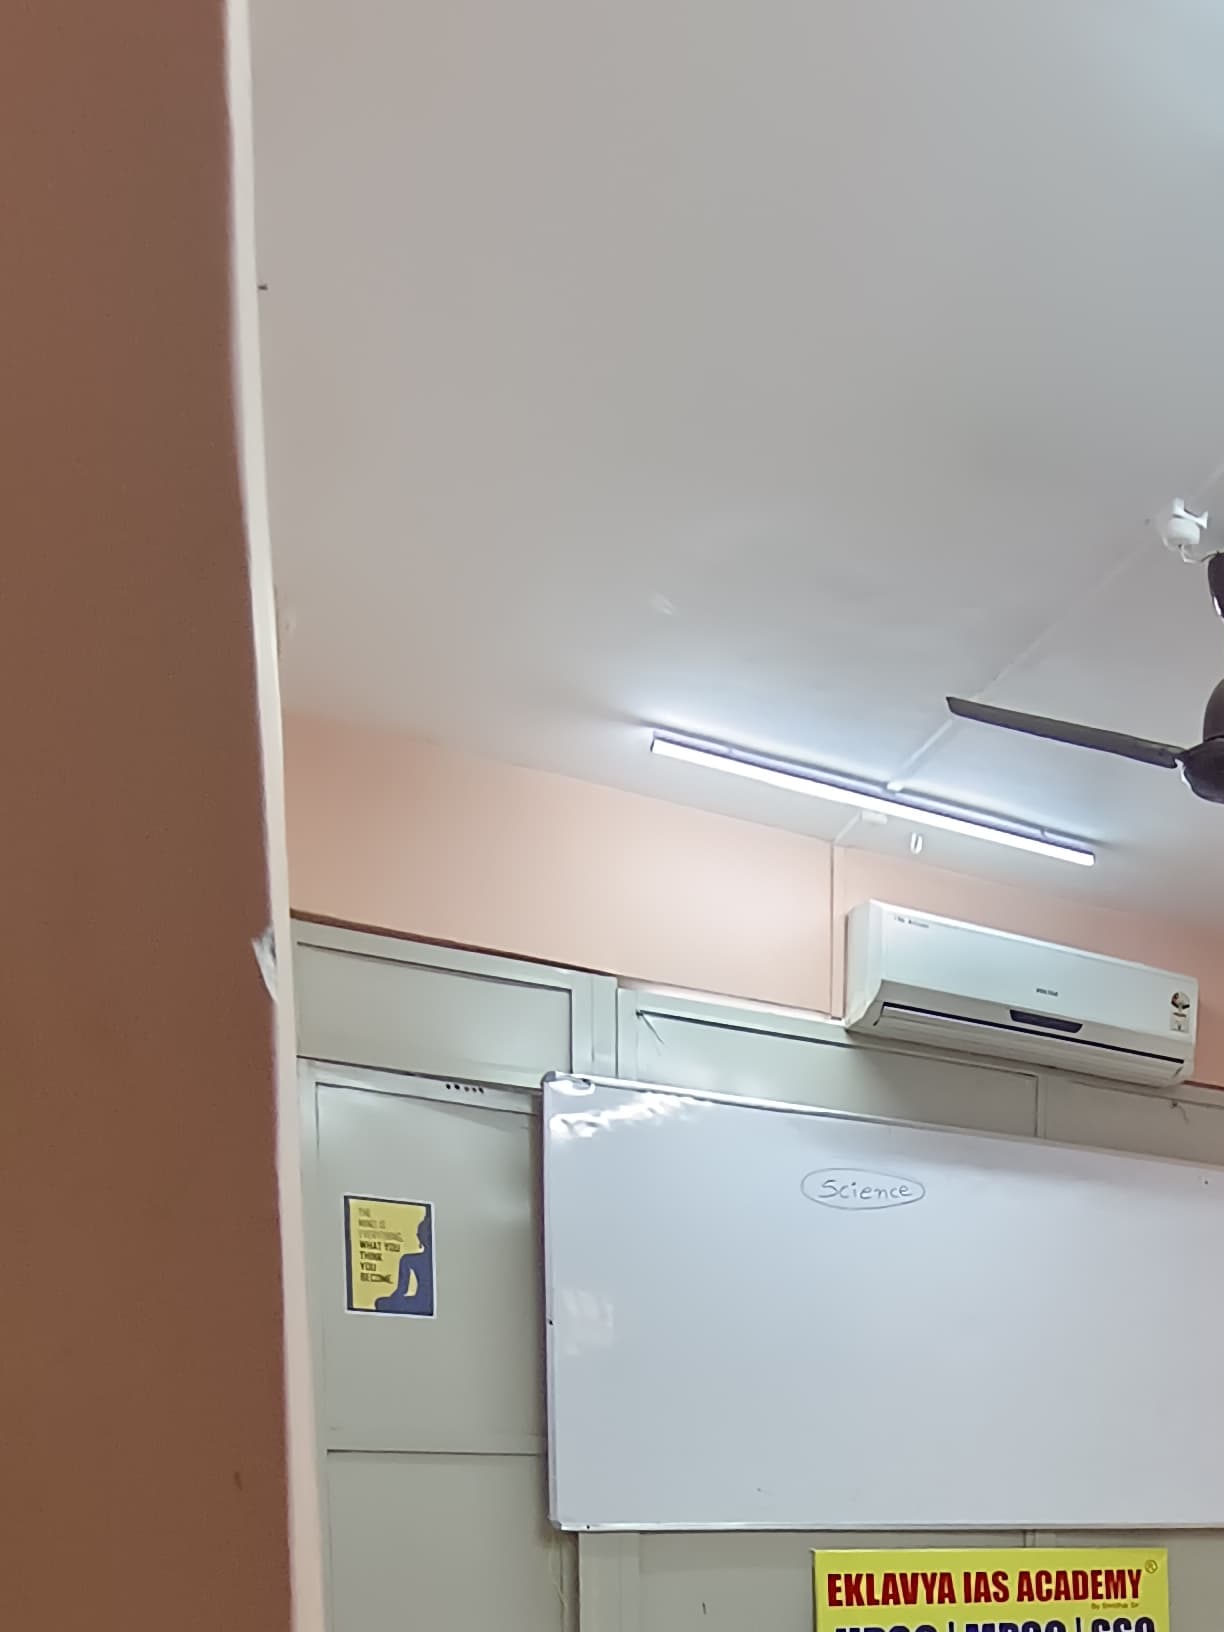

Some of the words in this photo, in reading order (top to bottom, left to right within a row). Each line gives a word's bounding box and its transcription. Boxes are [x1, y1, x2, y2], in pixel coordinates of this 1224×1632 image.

[818, 1179, 912, 1199] Science
[360, 1240, 382, 1250] WHAT
[360, 1262, 376, 1271] YOU
[827, 1572, 956, 1607] EKLAVYA
[963, 1571, 1010, 1604] IAS
[1016, 1569, 1142, 1602] ACADEMY
